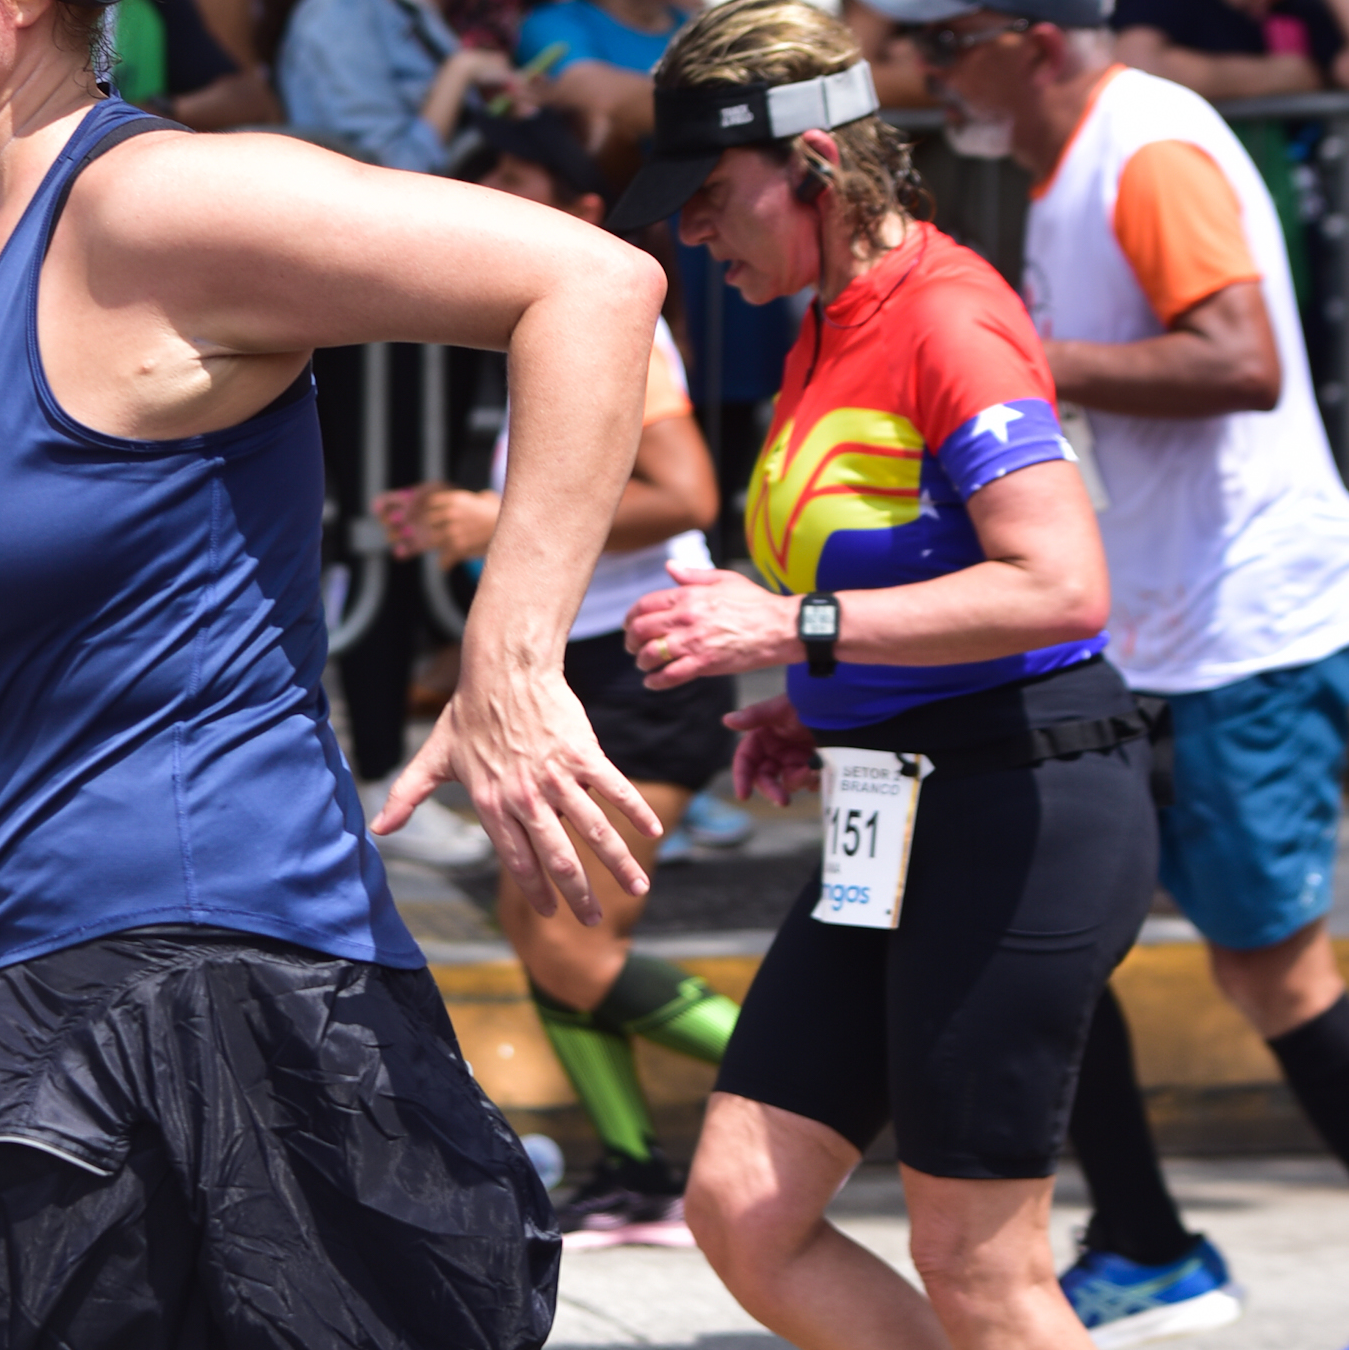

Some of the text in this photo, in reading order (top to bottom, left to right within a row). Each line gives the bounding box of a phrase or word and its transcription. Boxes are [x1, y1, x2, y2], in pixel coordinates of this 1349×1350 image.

[842, 765, 890, 780] SETOR
[841, 780, 901, 796] BRANCO
[825, 805, 880, 858] 151
